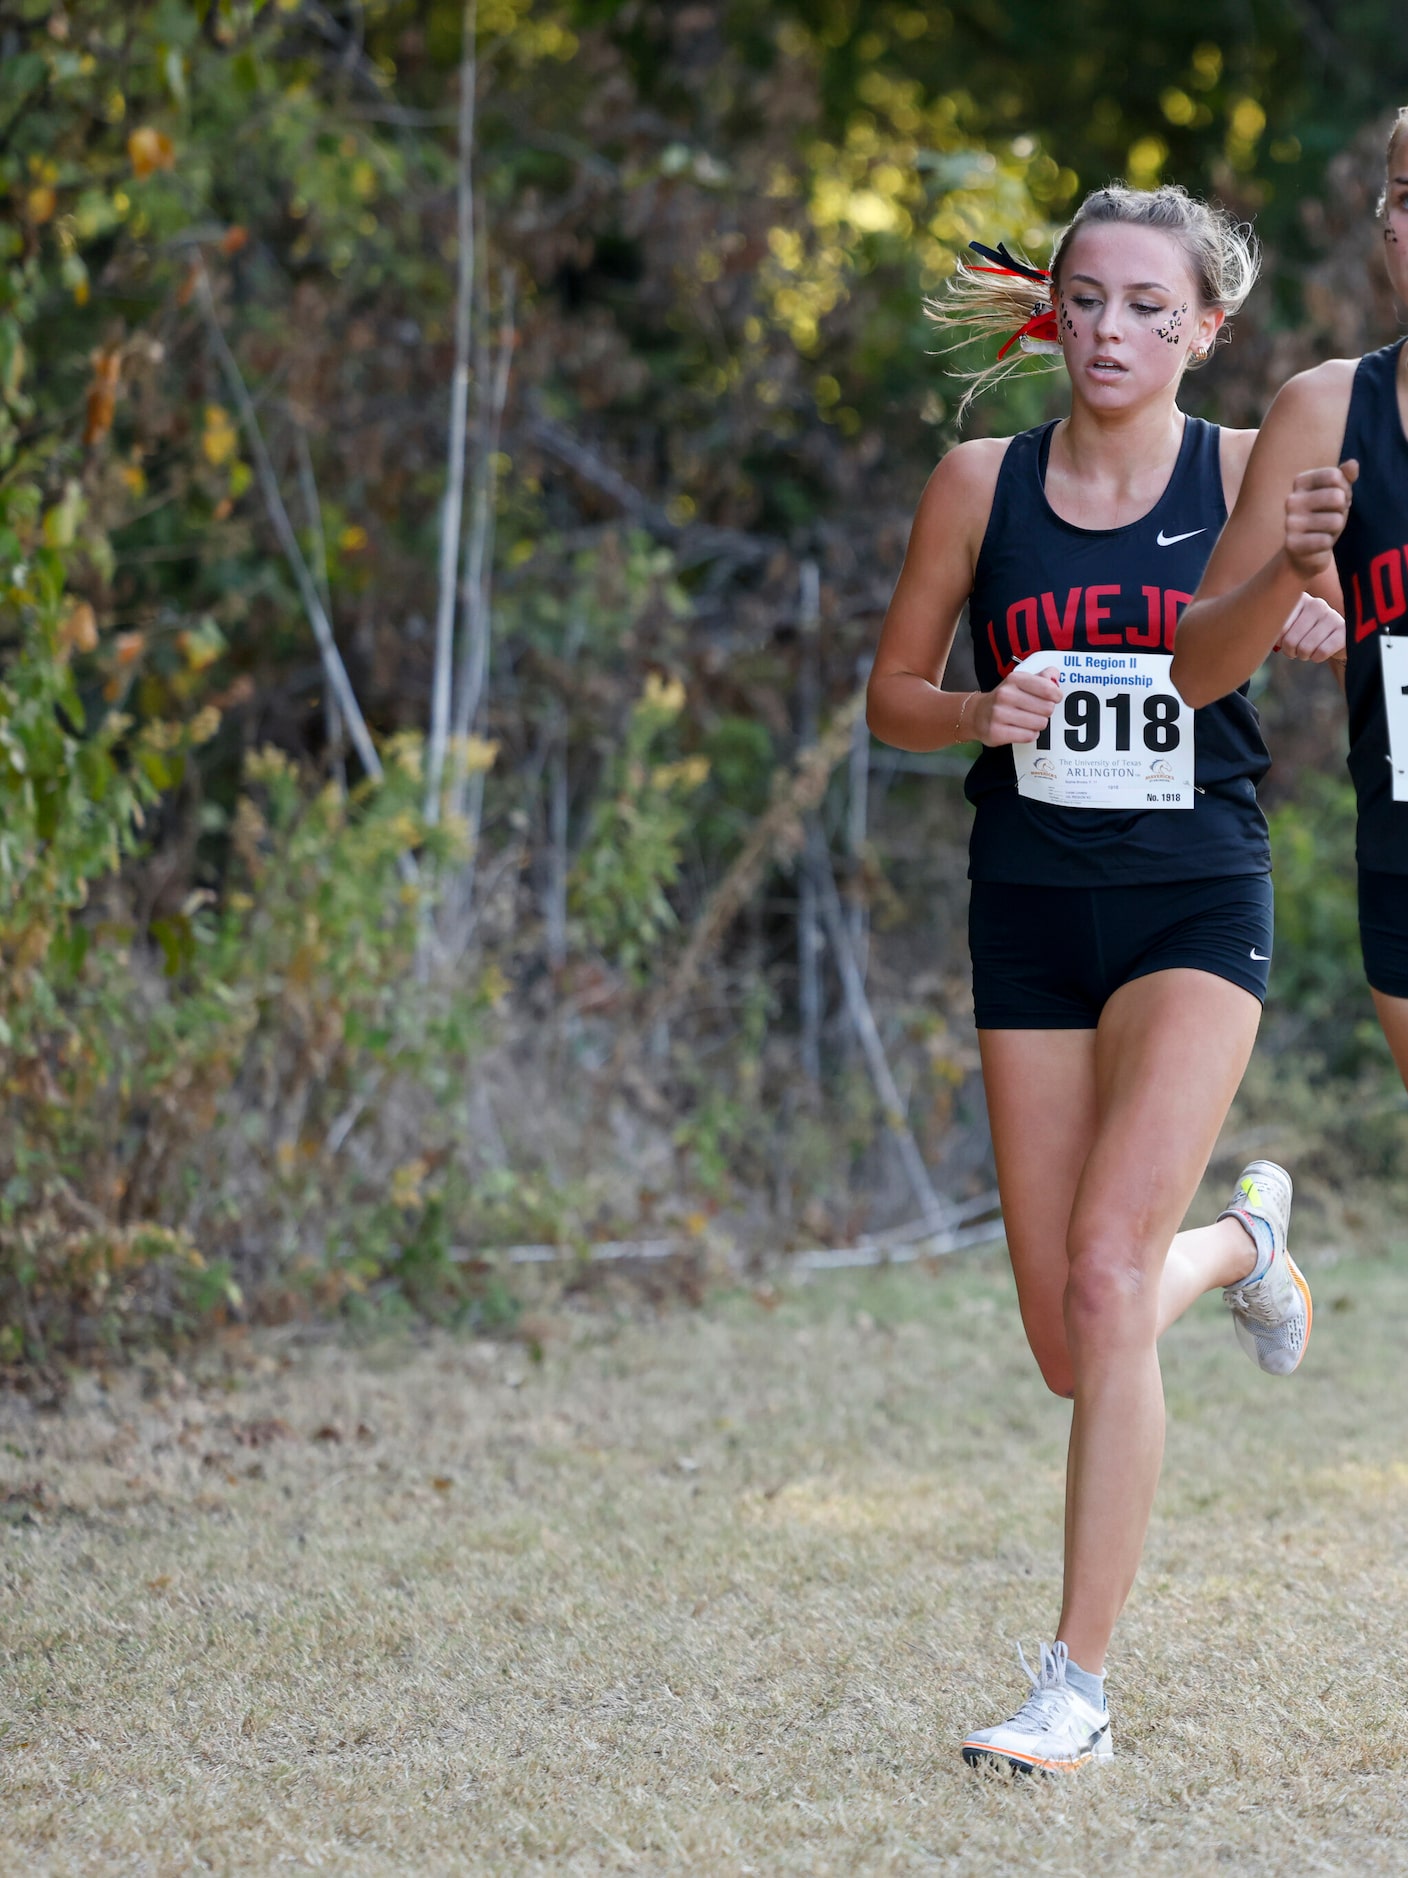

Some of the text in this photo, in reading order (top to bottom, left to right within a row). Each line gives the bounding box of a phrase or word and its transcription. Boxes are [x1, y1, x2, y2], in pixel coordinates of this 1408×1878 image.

[1064, 656, 1137, 670] UIL Region II
[1059, 672, 1153, 688] C Championship
[1074, 759, 1109, 767] University
[1066, 768, 1135, 778] ARLINGTON
[1146, 793, 1181, 802] No. 1918
